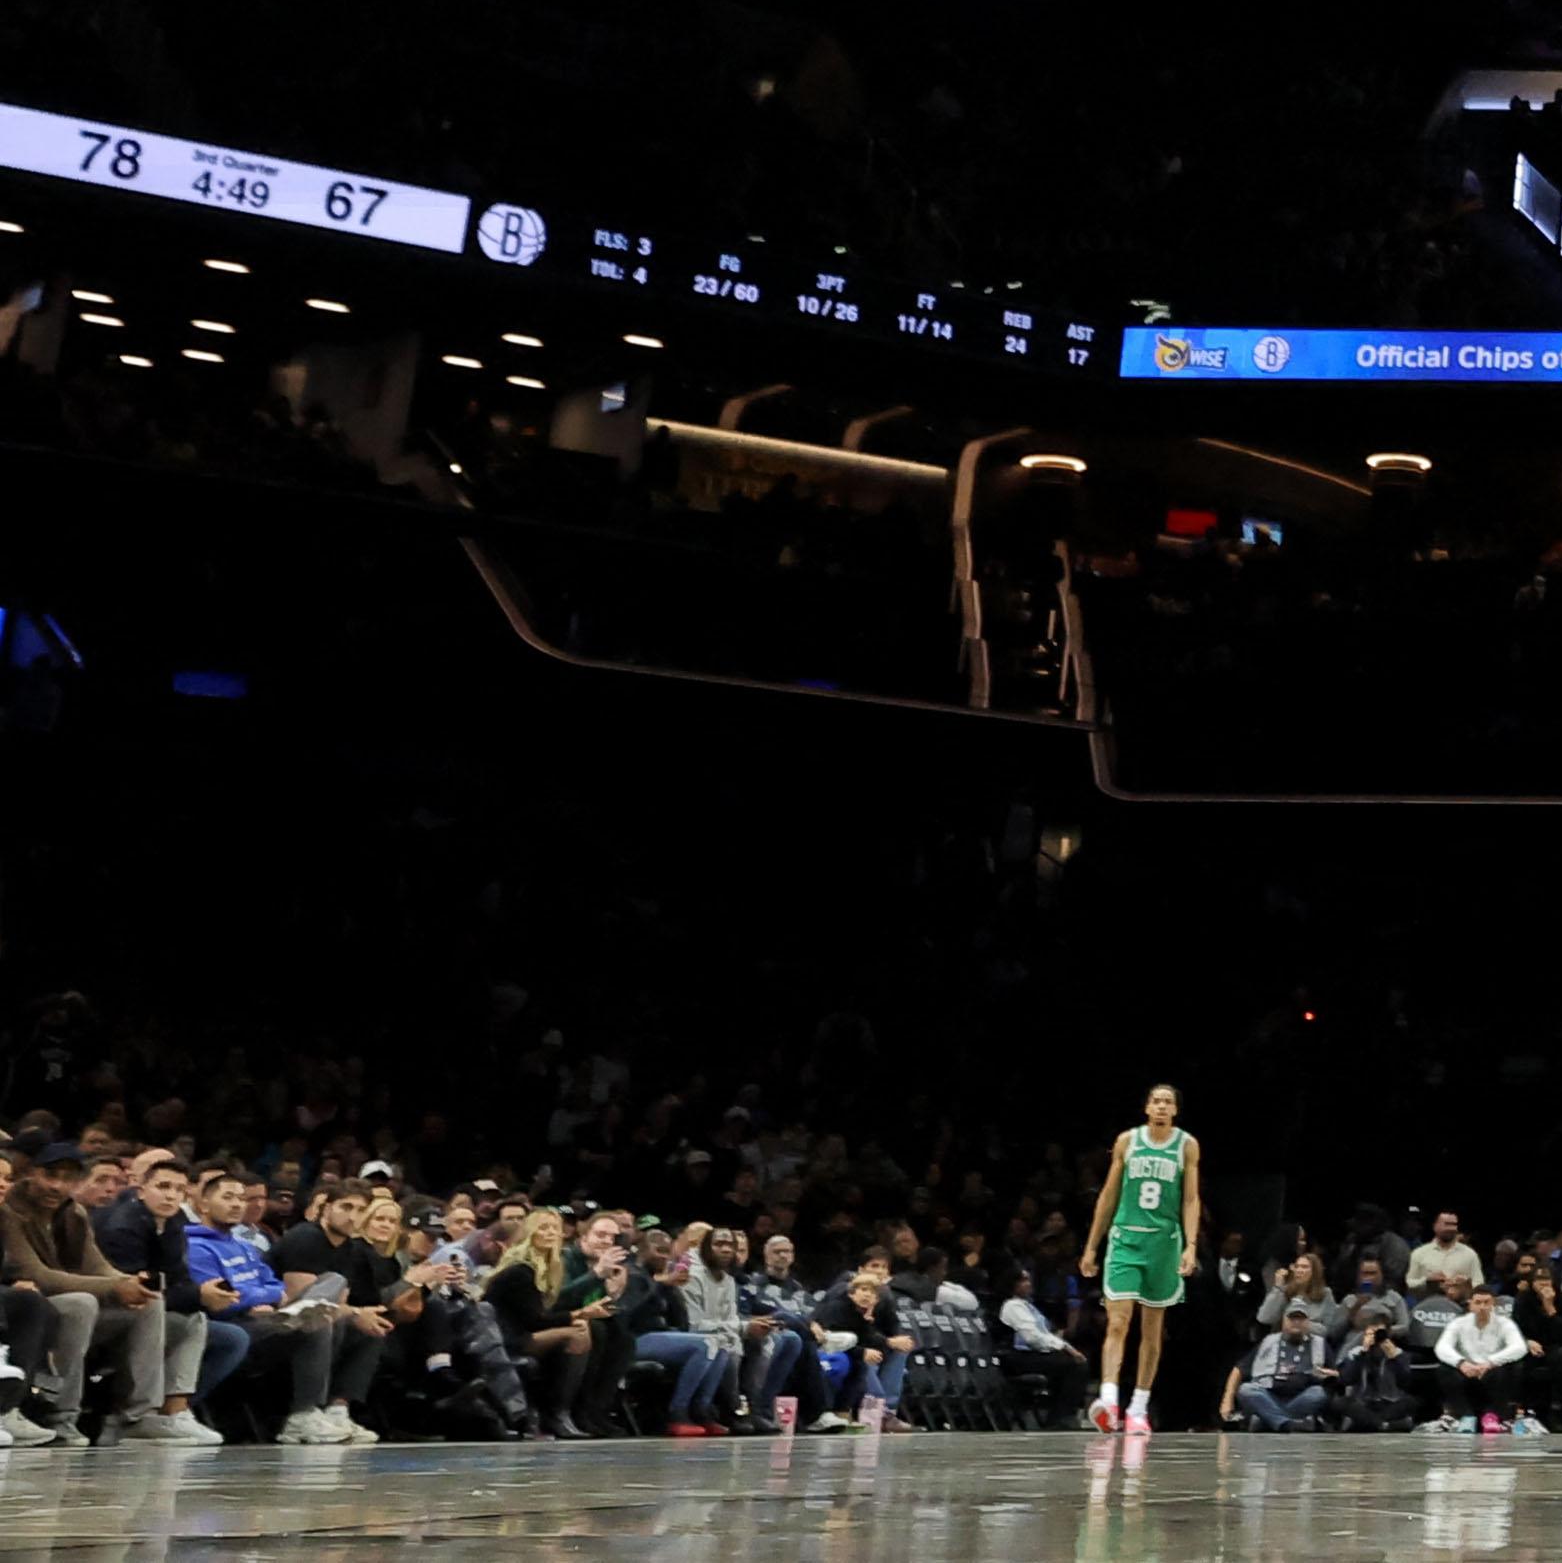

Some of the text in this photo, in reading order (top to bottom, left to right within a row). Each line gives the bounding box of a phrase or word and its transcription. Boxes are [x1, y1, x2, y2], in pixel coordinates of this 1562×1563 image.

[222, 155, 280, 177] Quarter
[80, 130, 389, 226] 78 4:49 67
[637, 237, 652, 256] 3
[633, 267, 648, 285] 4
[816, 273, 845, 293] 3PT
[917, 293, 936, 311] FT
[1066, 323, 1095, 342] AST
[1005, 335, 1027, 354] 24
[1068, 347, 1089, 366] 17
[1189, 349, 1224, 368] WISE
[1355, 344, 1449, 369] Official
[1458, 346, 1533, 373] Chips
[1139, 1181, 1162, 1210] 8
